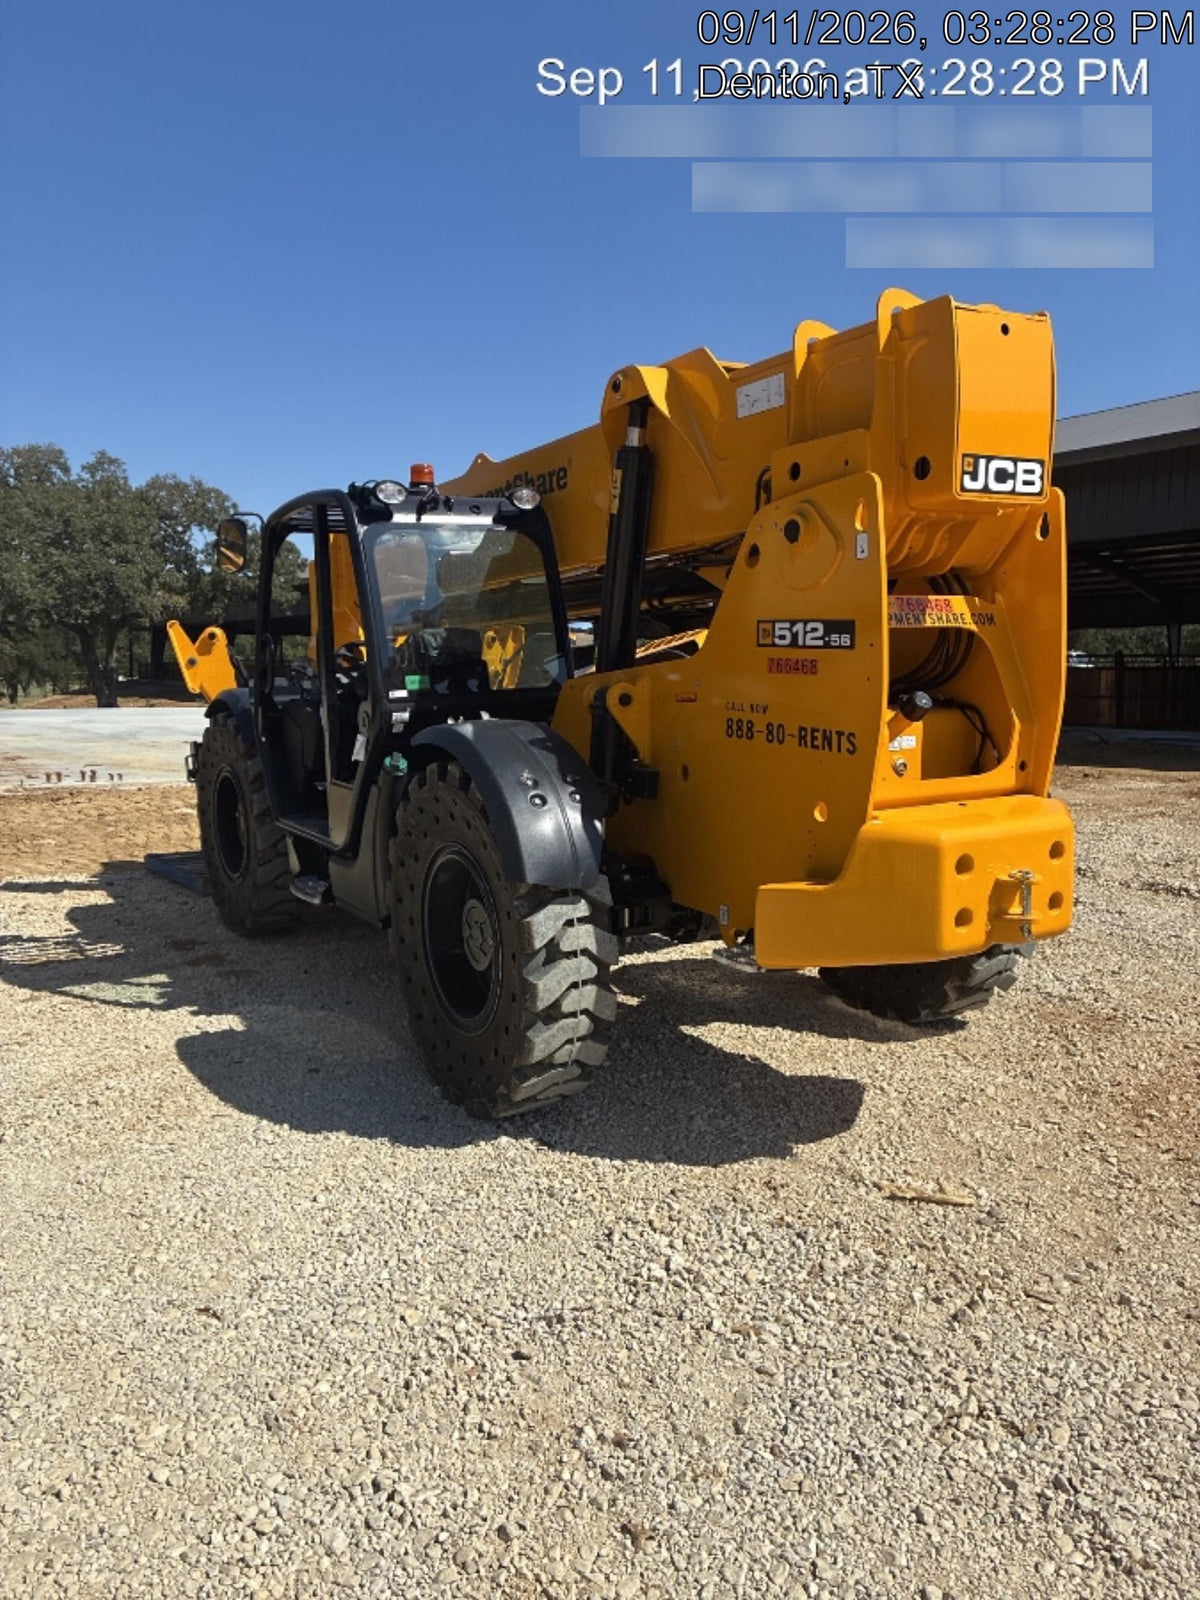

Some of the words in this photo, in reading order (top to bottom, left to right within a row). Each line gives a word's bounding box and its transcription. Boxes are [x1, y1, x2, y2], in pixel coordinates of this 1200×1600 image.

[963, 458, 1042, 493] JCB
[750, 703, 768, 714] NOW
[726, 717, 857, 755] 888-80-RENTS
